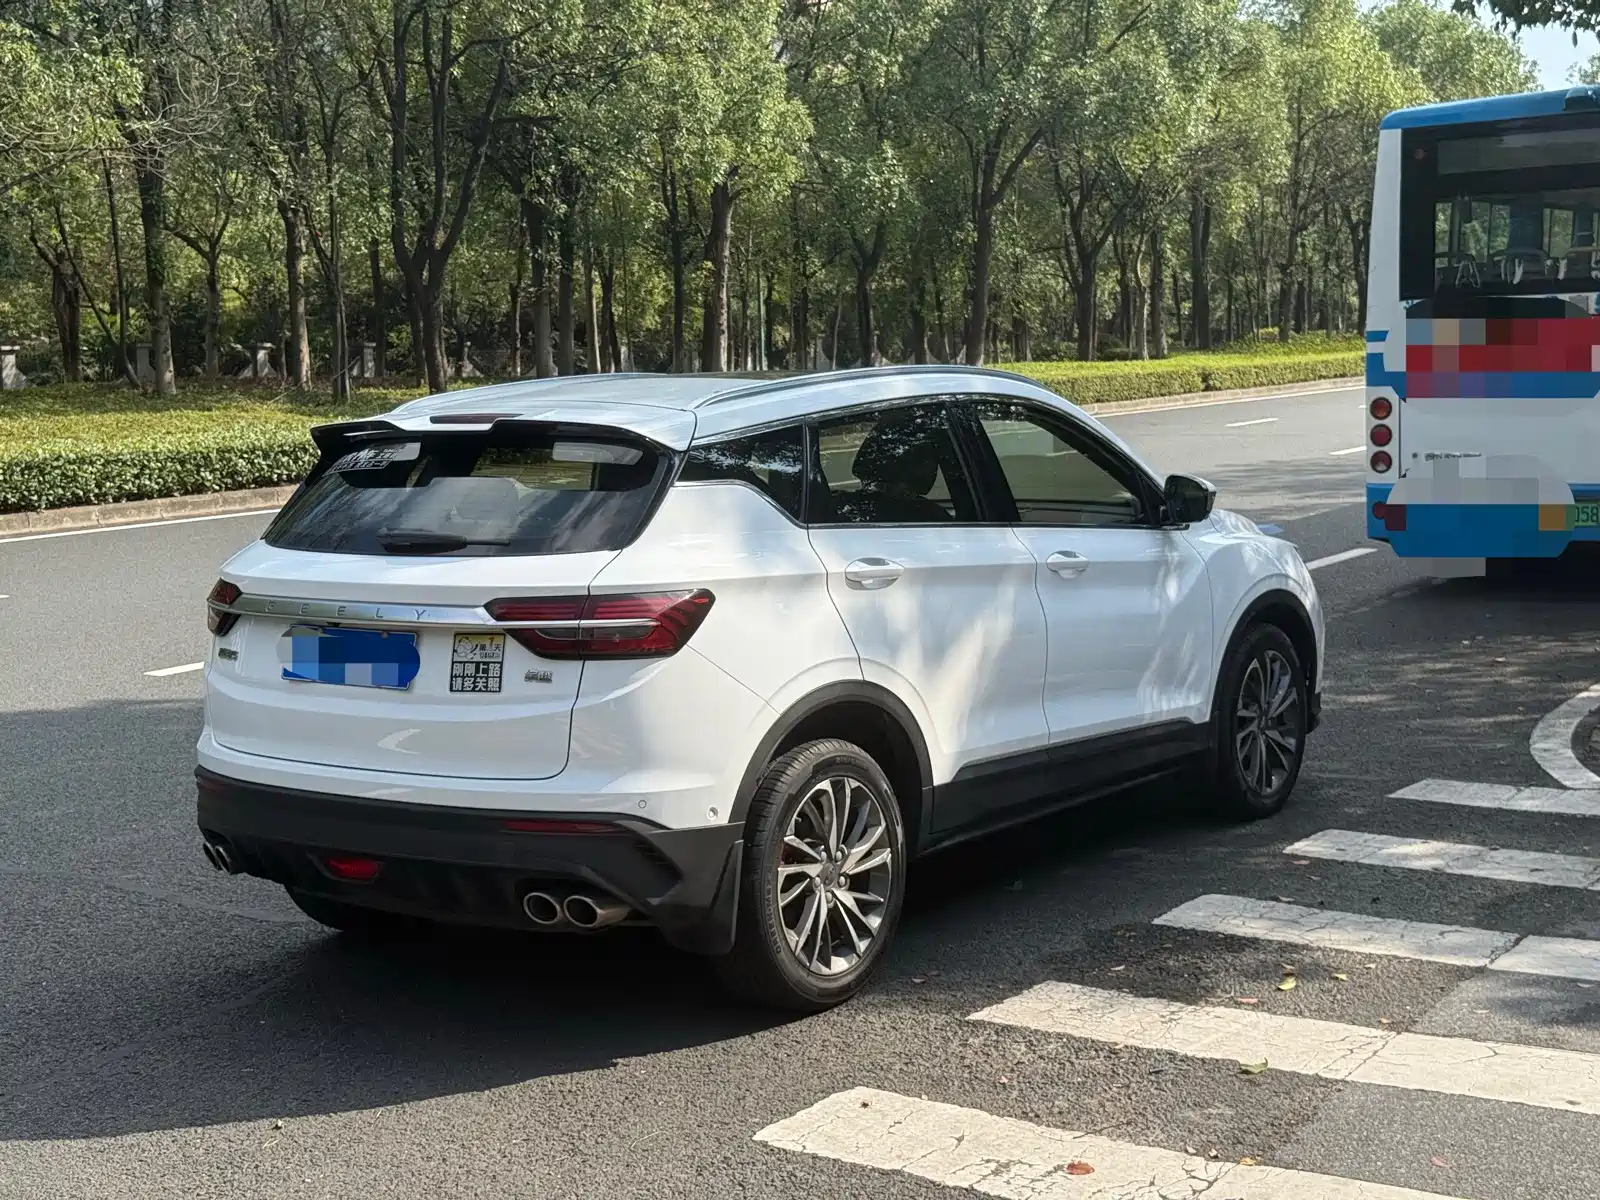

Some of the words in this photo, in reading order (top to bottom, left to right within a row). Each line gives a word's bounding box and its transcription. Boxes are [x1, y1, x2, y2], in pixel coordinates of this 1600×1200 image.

[266, 601, 426, 620] GEELY
[452, 663, 501, 677] 刚刚上路
[451, 677, 500, 691] 请多关照
